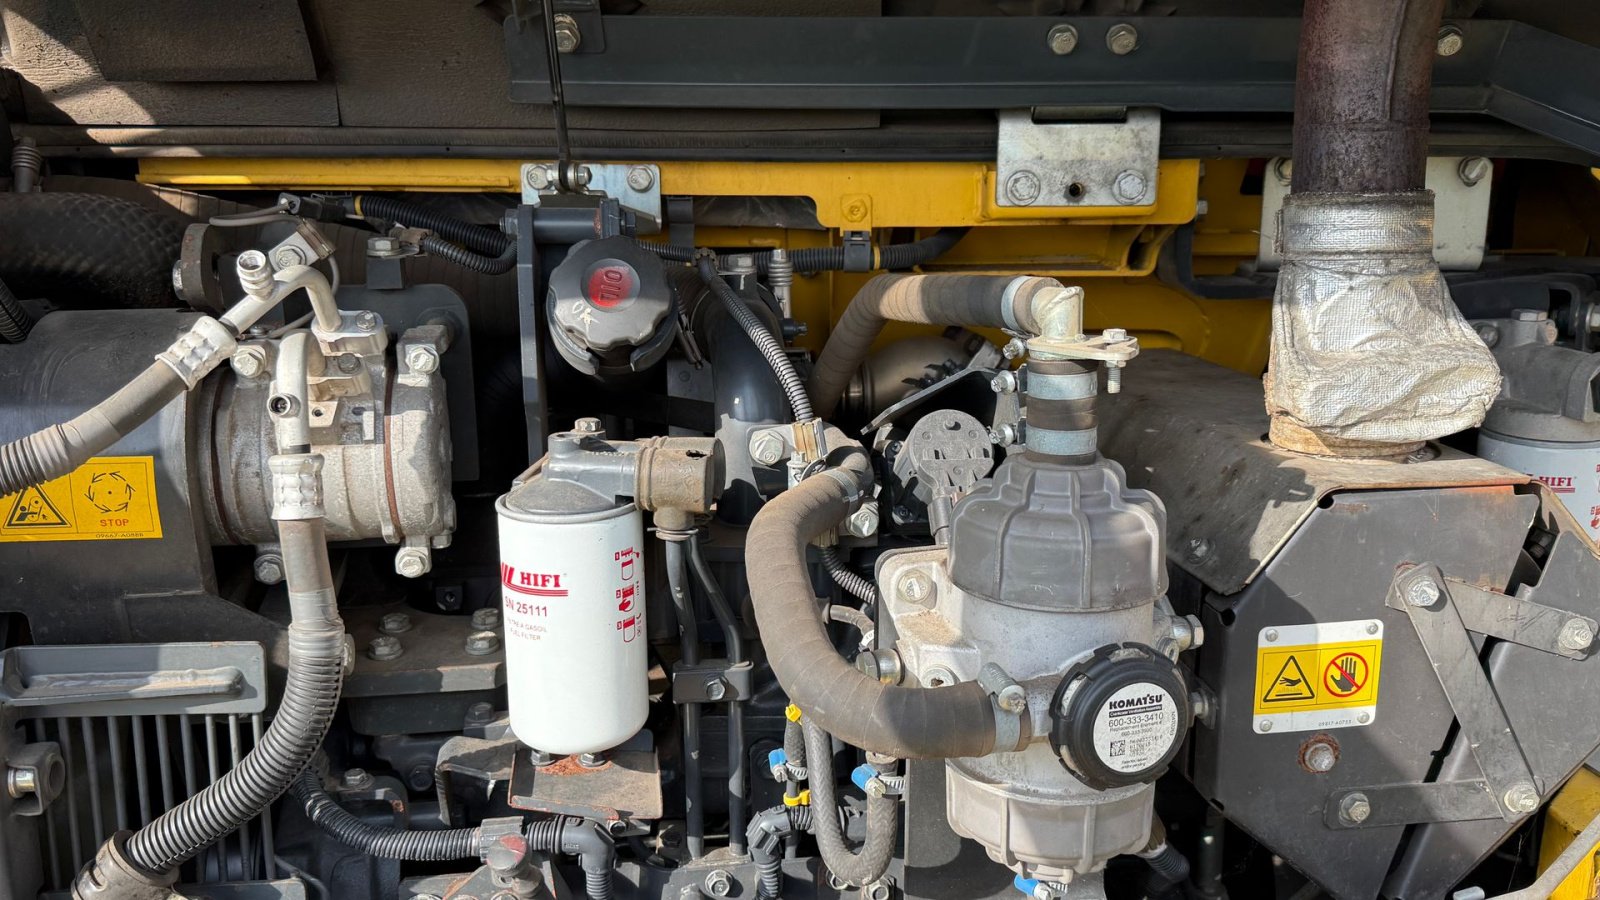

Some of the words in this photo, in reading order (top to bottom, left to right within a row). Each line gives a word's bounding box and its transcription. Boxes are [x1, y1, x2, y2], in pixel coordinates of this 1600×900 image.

[600, 269, 622, 302] OIL
[1539, 476, 1572, 487] HIFI
[99, 518, 129, 527] STOP
[520, 571, 561, 588] HIFI
[504, 595, 514, 611] SN
[516, 601, 547, 617] 25111
[1109, 694, 1163, 710] KOMATSU
[1108, 712, 1164, 727] 600-333-3410
